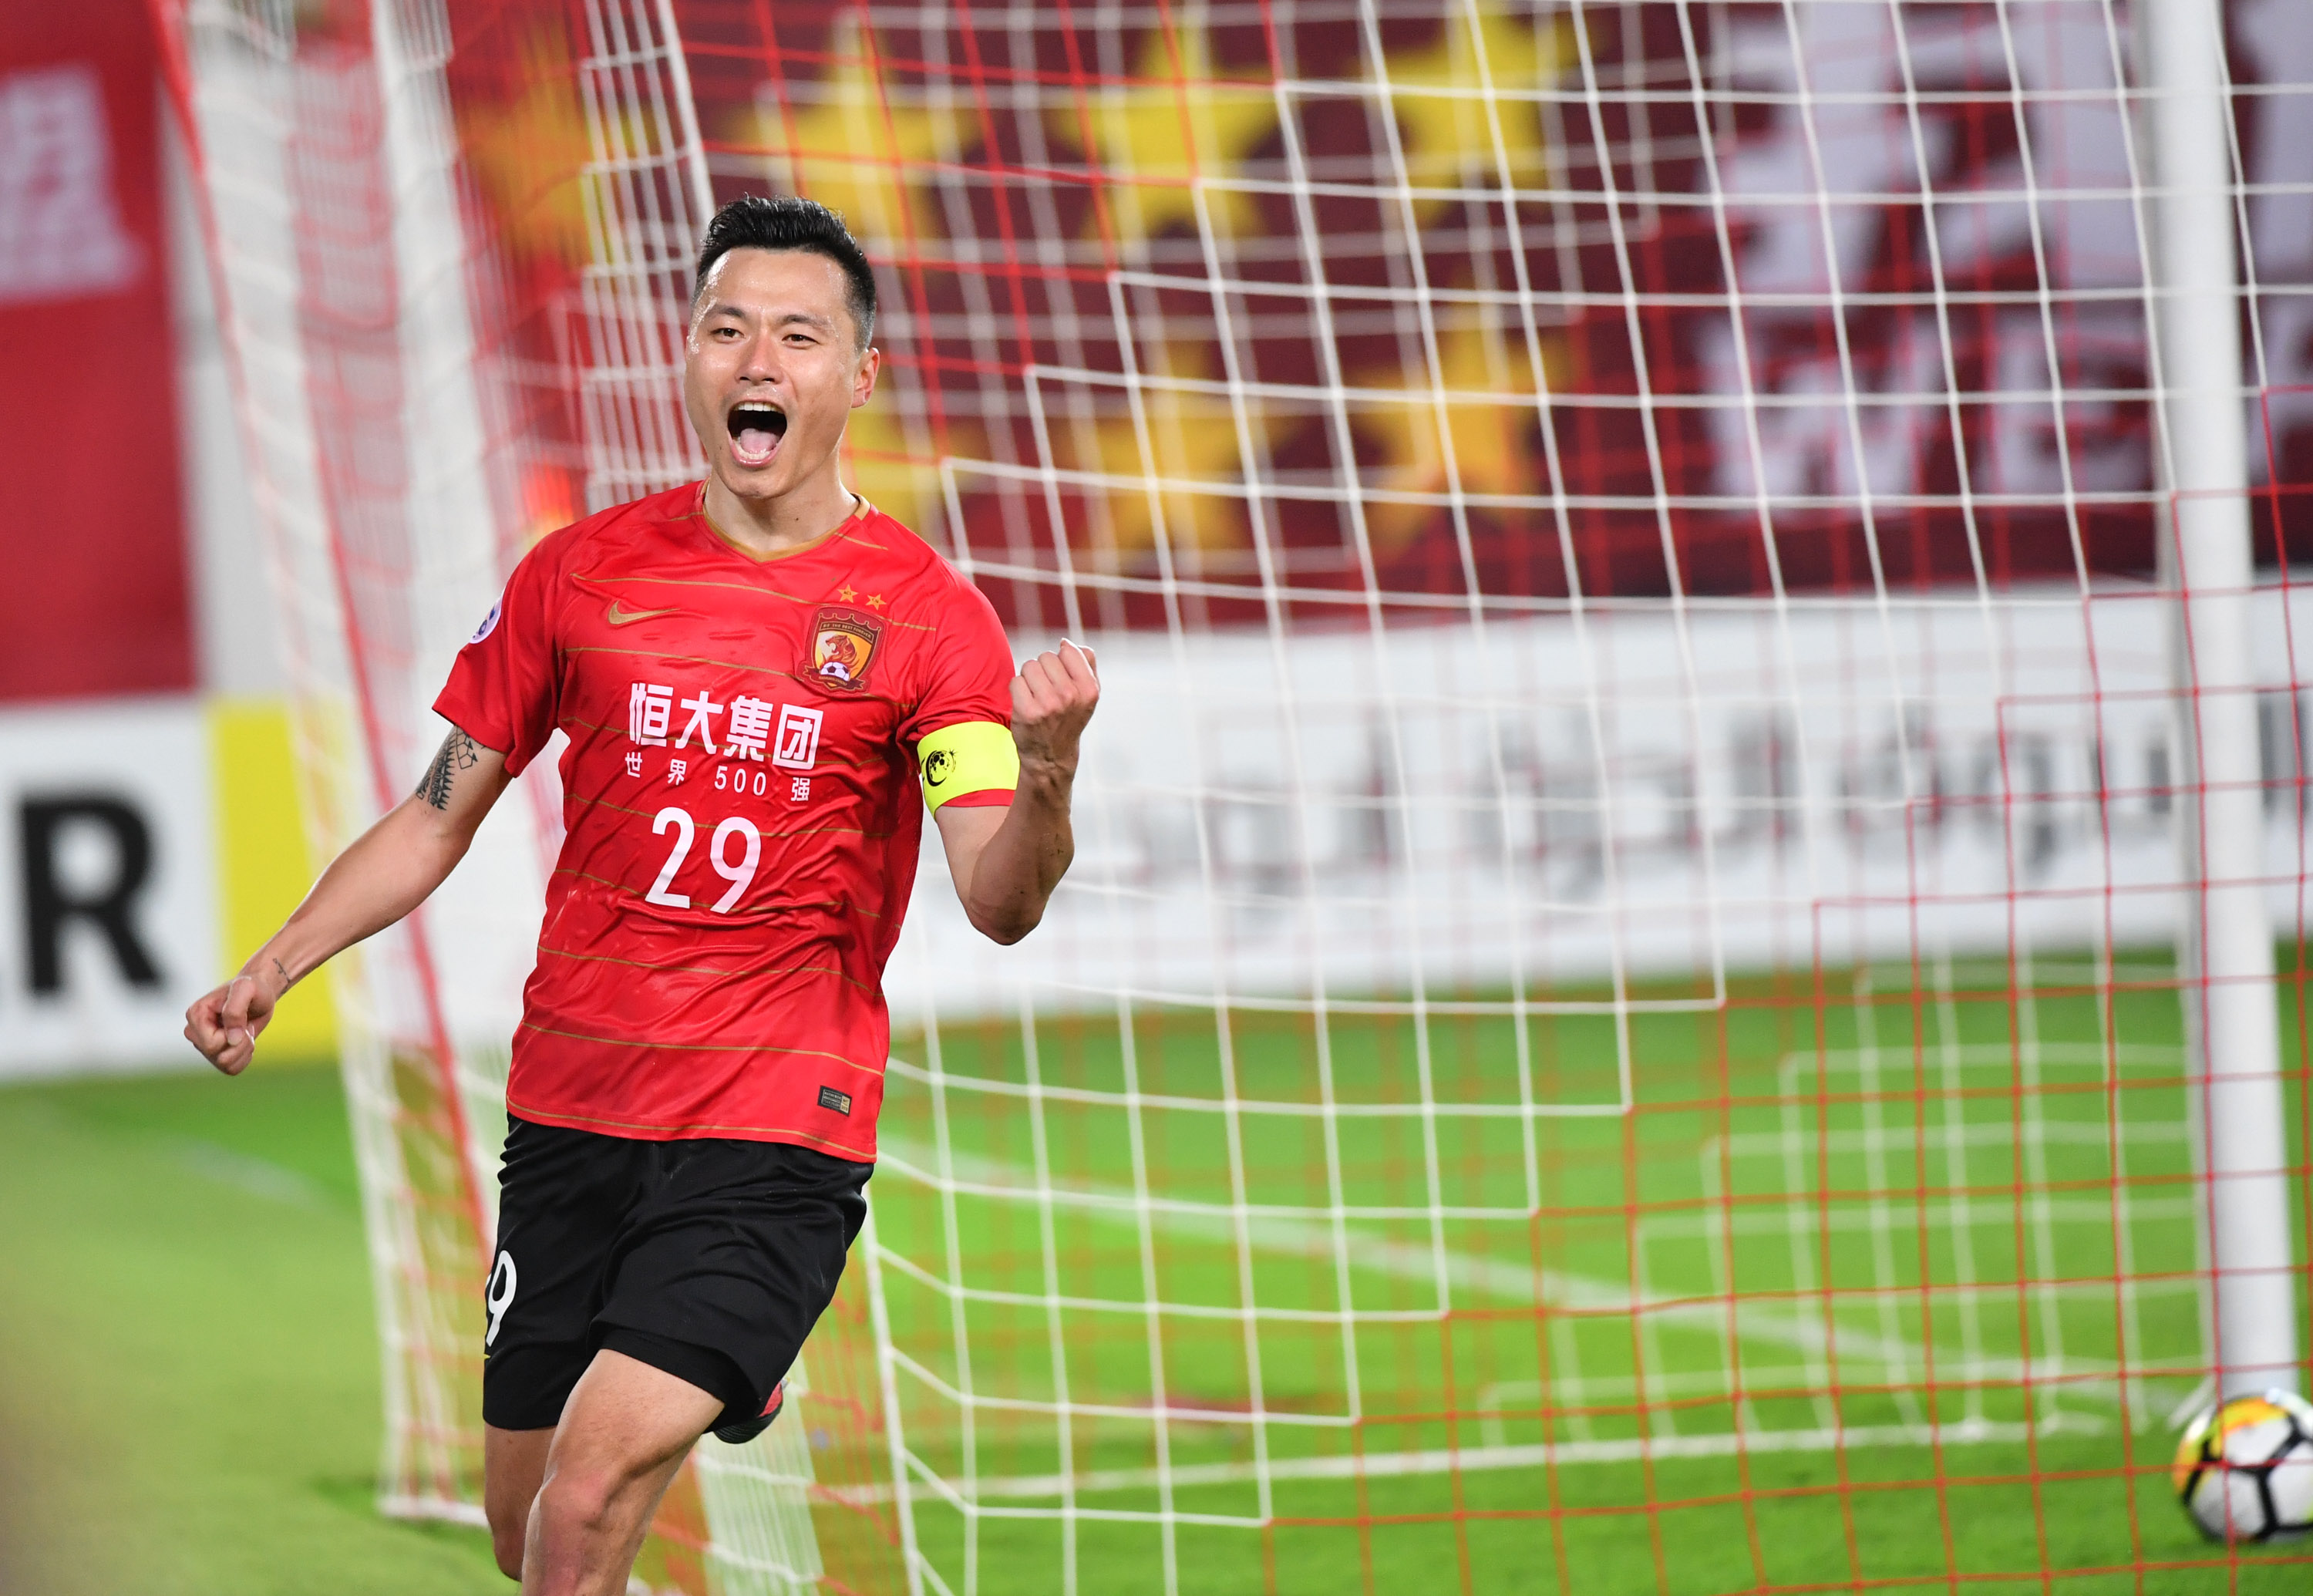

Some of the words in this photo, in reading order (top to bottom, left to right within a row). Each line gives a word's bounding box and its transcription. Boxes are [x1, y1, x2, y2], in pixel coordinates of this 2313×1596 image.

[628, 682, 824, 770] 恒大集团
[645, 806, 763, 914] 29
